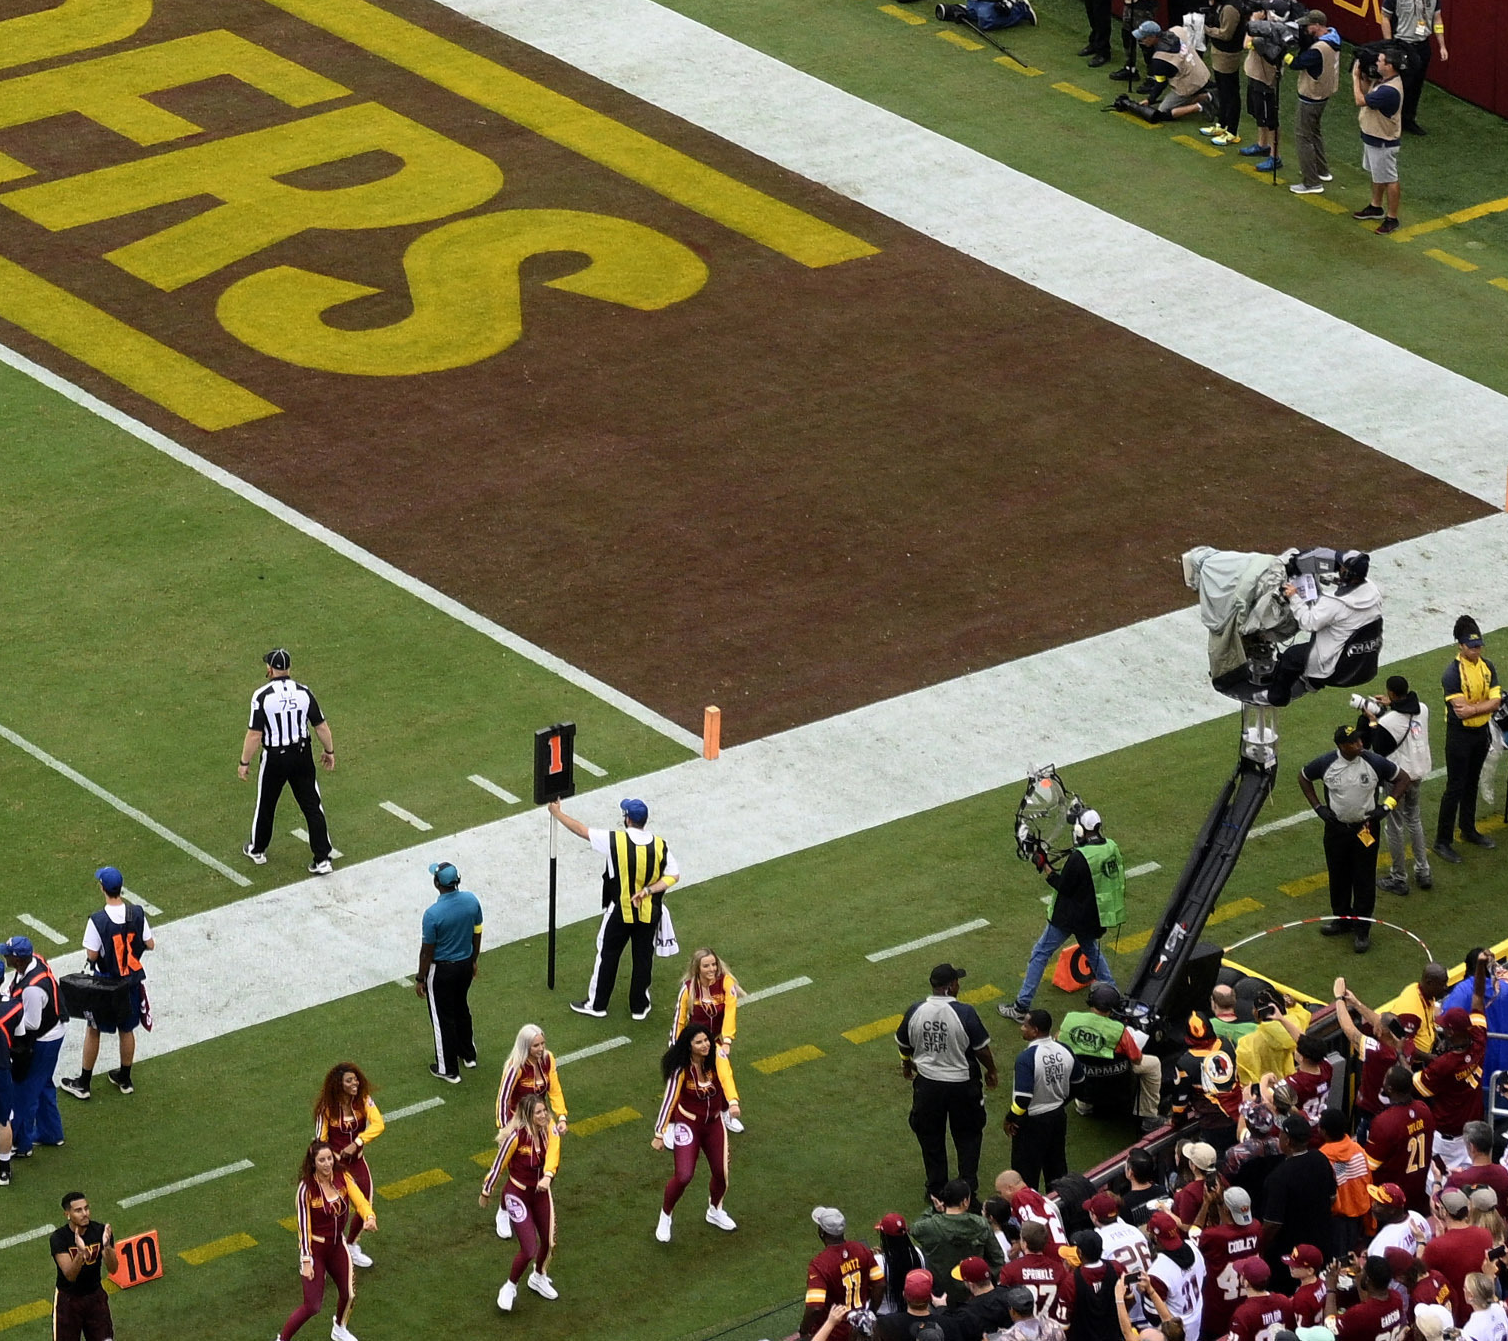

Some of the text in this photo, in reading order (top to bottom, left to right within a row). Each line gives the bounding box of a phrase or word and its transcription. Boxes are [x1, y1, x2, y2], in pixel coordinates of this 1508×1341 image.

[279, 699, 298, 710] 75
[548, 736, 562, 775] 1
[923, 1021, 949, 1032] CSC
[923, 1032, 948, 1043] EVENT
[924, 1042, 949, 1054] STAFF
[1042, 1053, 1063, 1066] CSC
[1405, 1133, 1425, 1175] 21
[1228, 1236, 1258, 1255] COOLEY
[121, 1235, 159, 1282] 10
[1021, 1267, 1055, 1280] SPRINKLE
